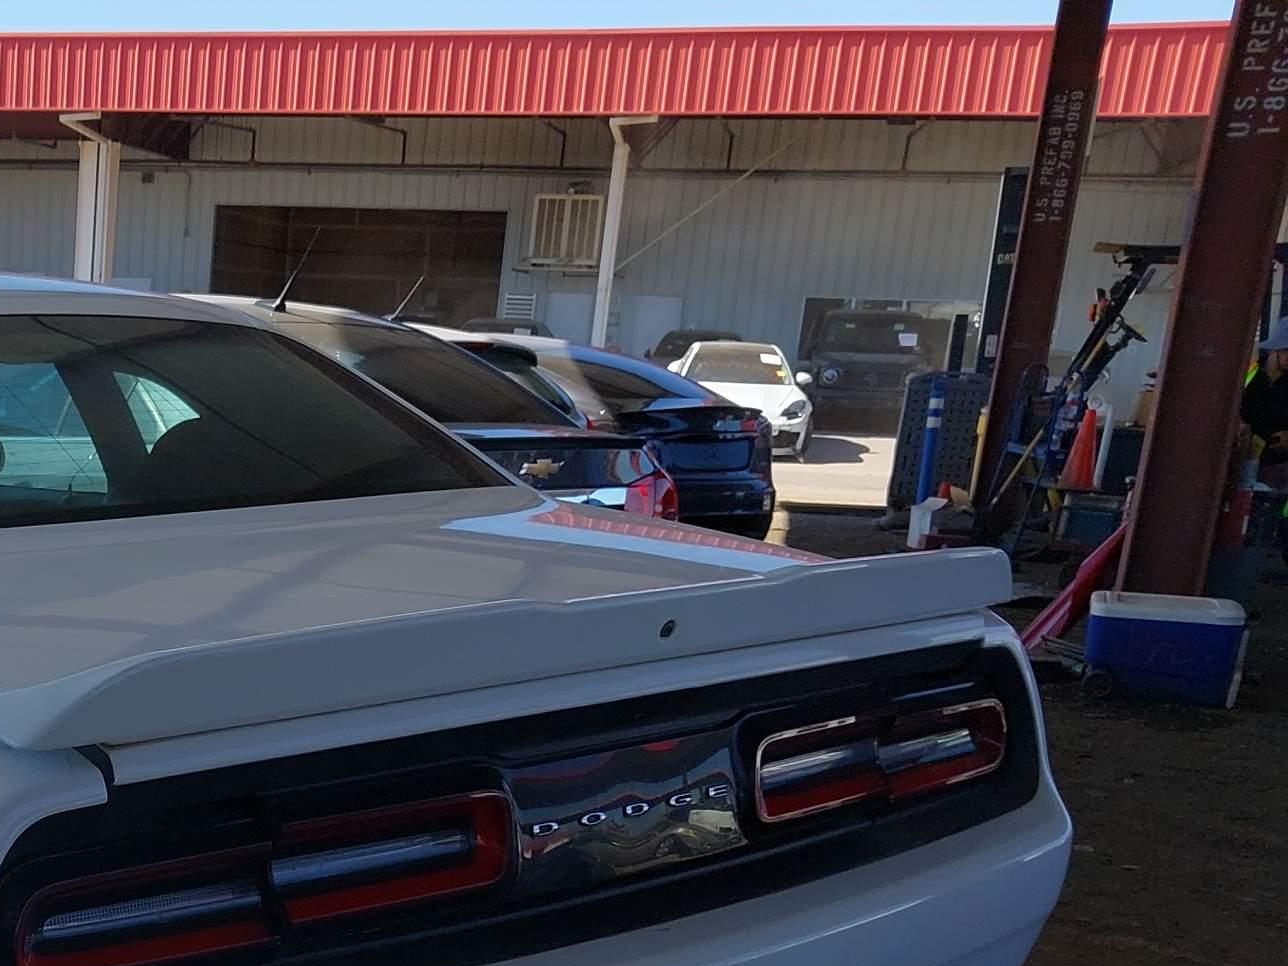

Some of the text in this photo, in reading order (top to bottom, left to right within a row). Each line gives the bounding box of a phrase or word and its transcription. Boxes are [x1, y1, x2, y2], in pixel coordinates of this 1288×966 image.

[1050, 89, 1070, 119] INC.
[1039, 126, 1062, 186] PREFAB
[532, 784, 728, 837] DODGE
